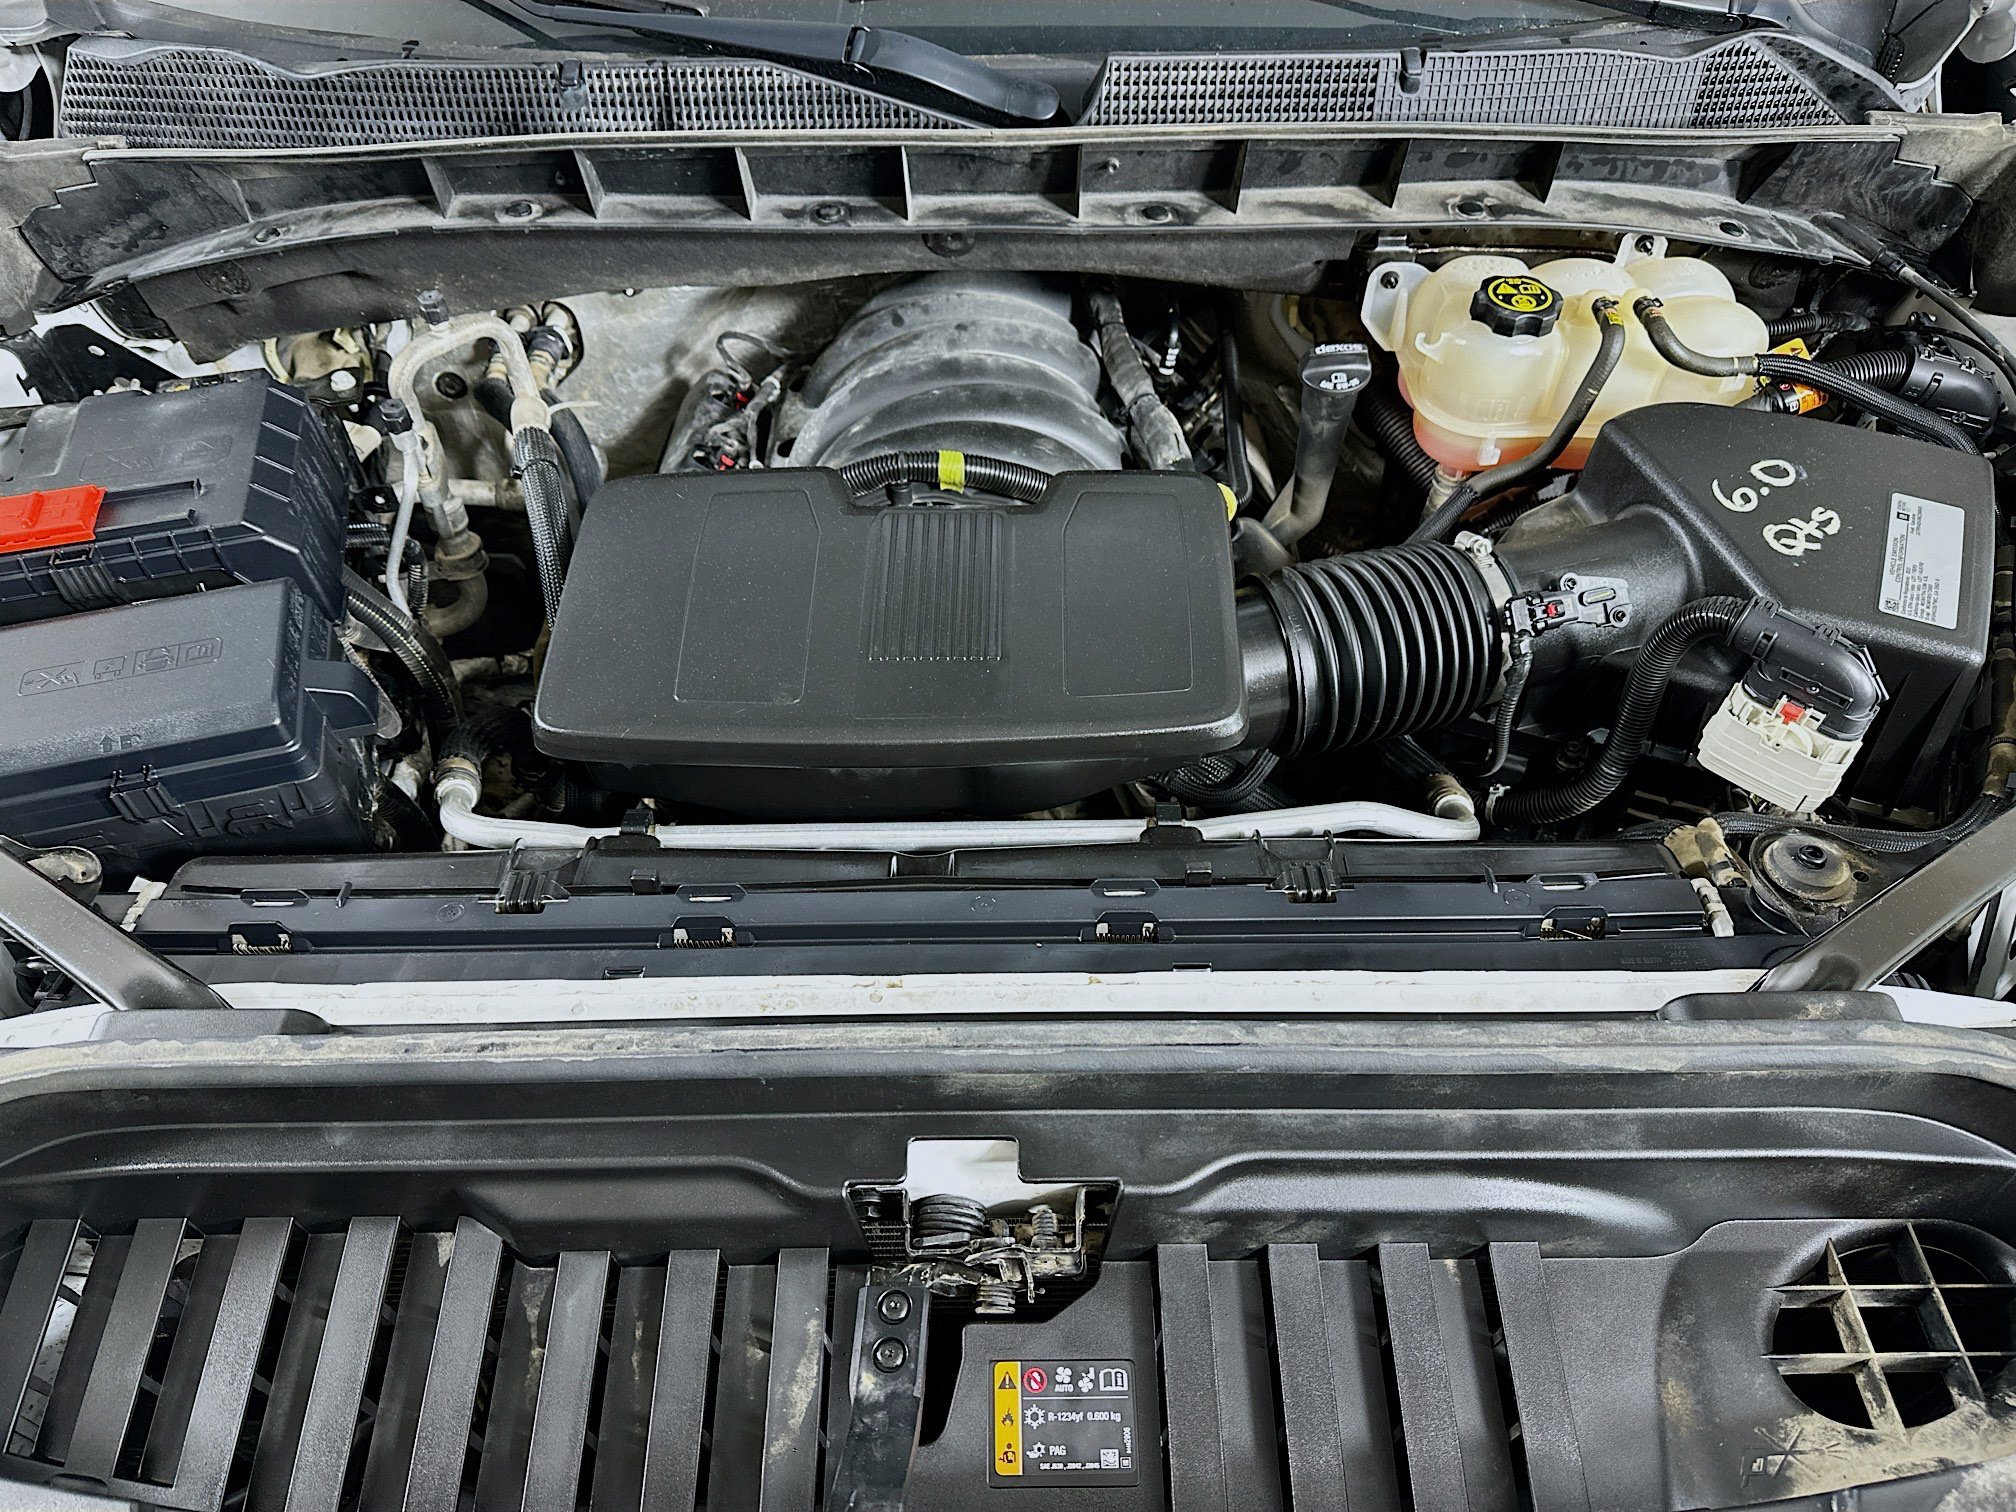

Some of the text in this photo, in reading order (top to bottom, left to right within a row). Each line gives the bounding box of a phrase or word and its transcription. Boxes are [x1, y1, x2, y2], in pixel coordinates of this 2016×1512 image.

[1314, 343, 1363, 355] dexos
[1711, 459, 1797, 513] 6.0
[1054, 1384, 1074, 1393] AUTO
[1047, 1411, 1122, 1424] R-1234yf 0.600 kg
[1049, 1445, 1067, 1456] PAG
